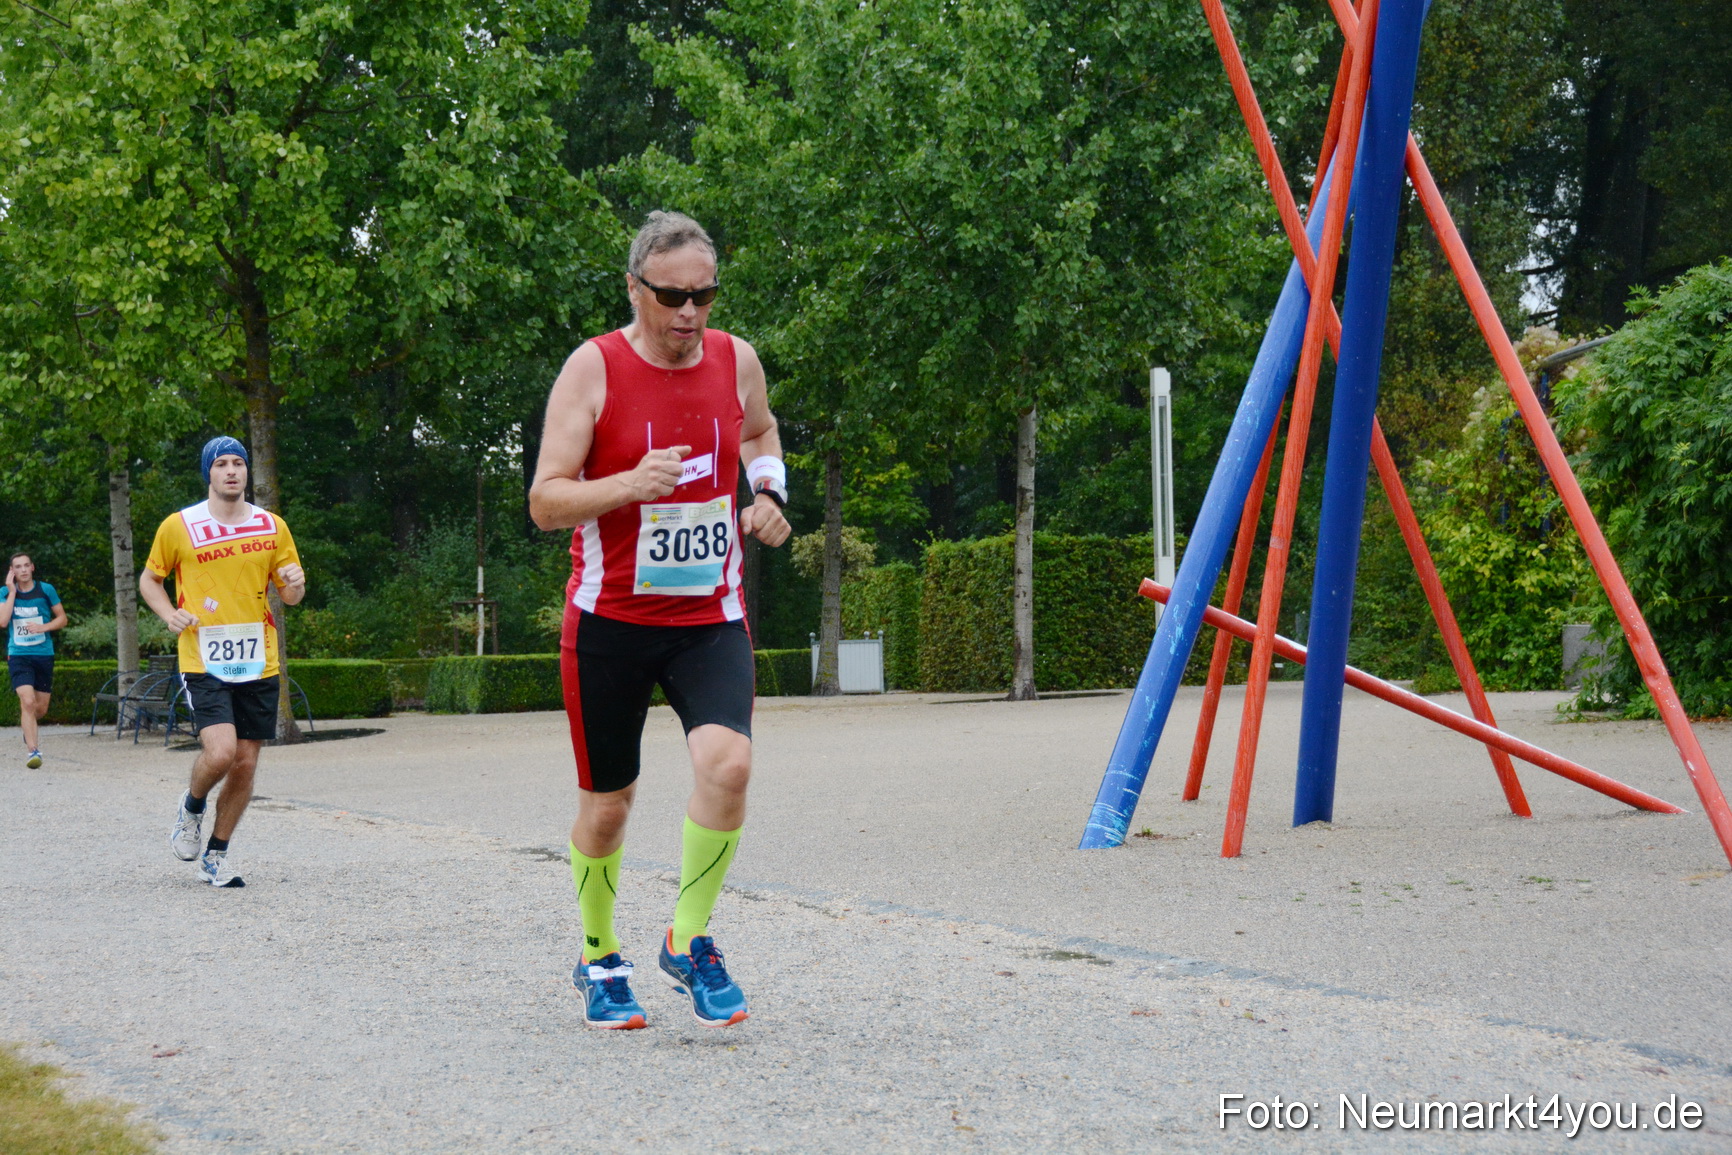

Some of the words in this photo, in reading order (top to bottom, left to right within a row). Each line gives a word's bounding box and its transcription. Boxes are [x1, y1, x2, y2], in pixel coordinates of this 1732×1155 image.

[196, 546, 236, 564] MAX
[241, 539, 278, 554] BÖGL
[650, 522, 728, 562] 3038
[208, 638, 258, 661] 2817
[223, 666, 247, 675] Stefan
